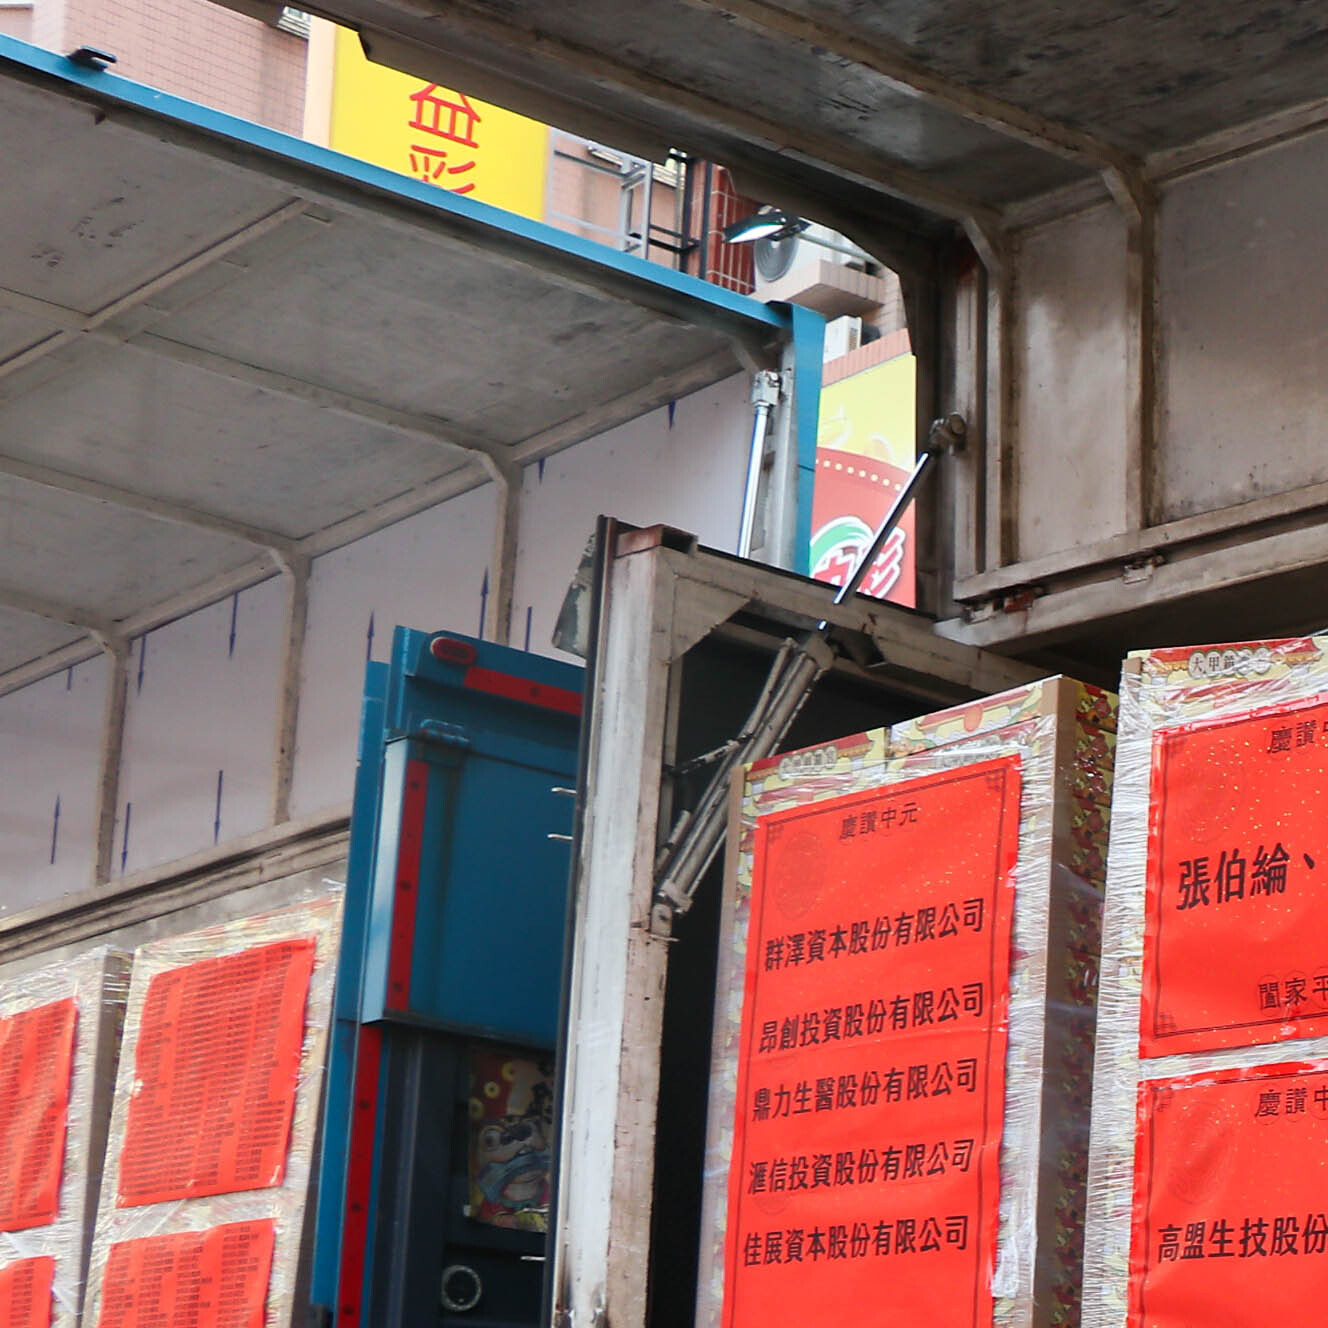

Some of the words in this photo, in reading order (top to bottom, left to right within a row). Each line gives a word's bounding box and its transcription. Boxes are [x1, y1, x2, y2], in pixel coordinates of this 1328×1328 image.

[743, 1215, 969, 1267] 佳展資本股份有限公司
